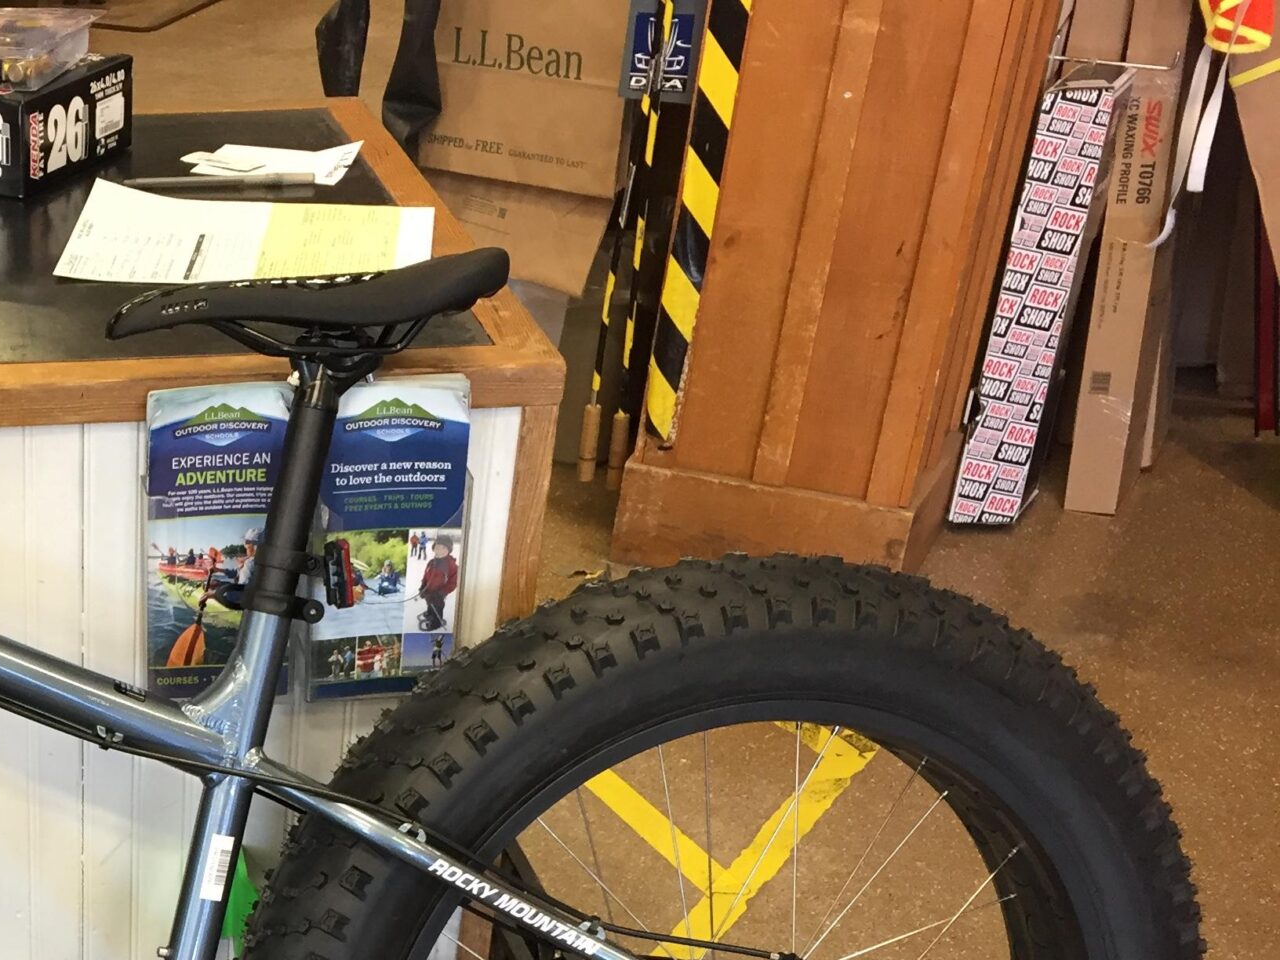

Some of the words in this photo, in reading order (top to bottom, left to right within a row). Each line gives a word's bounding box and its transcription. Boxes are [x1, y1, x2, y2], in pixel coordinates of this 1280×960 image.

[452, 26, 583, 81] L.L.Bean
[630, 76, 683, 89] DA
[47, 95, 86, 174] 26
[1122, 113, 1139, 159] WAXING
[29, 111, 40, 180] KENDA
[427, 133, 465, 149] SHIPPED
[475, 139, 504, 155] FREE
[508, 149, 554, 164] GUARANTEED
[555, 157, 566, 166] TO
[1028, 159, 1053, 180] HOX
[1116, 162, 1132, 205] PROFILE
[1136, 161, 1156, 205] T0766
[1033, 187, 1056, 201] ROCK
[1026, 201, 1049, 216] SHOX
[1051, 210, 1084, 232] ROCK
[1041, 231, 1076, 252] SHOX
[1003, 271, 1029, 291] HOX
[1030, 288, 1062, 308] ROCK
[1020, 307, 1054, 328] SHOX
[984, 359, 1015, 379] ROCK
[981, 379, 1008, 398] HOX
[205, 410, 241, 420] L.L.Bean
[376, 405, 413, 415] L.L.Bean
[175, 422, 218, 437] OUTDOOR
[219, 421, 269, 430] DISCOVERY
[345, 418, 390, 431] OUTDOOR
[391, 417, 442, 429] DISCOVERY
[205, 431, 239, 440] SCHOOLS
[1006, 425, 1036, 445] ROCK
[172, 453, 250, 470] EXPERIENCE
[253, 452, 271, 465] AN
[998, 443, 1030, 463] SHOX
[330, 462, 379, 473] Discover
[381, 462, 388, 470] a
[389, 461, 413, 470] new
[414, 461, 452, 470] reason
[963, 461, 995, 481] ROCK
[175, 468, 267, 487] ADVENTURE
[335, 475, 347, 486] to
[349, 474, 372, 485] love
[374, 472, 393, 483] the
[394, 471, 446, 483] outdoors
[365, 502, 392, 510] EVENTS
[987, 495, 1019, 514] ROCK
[156, 675, 199, 685] COURSES
[427, 858, 499, 899] ROCKY
[493, 893, 603, 956] MOUNTAIN
